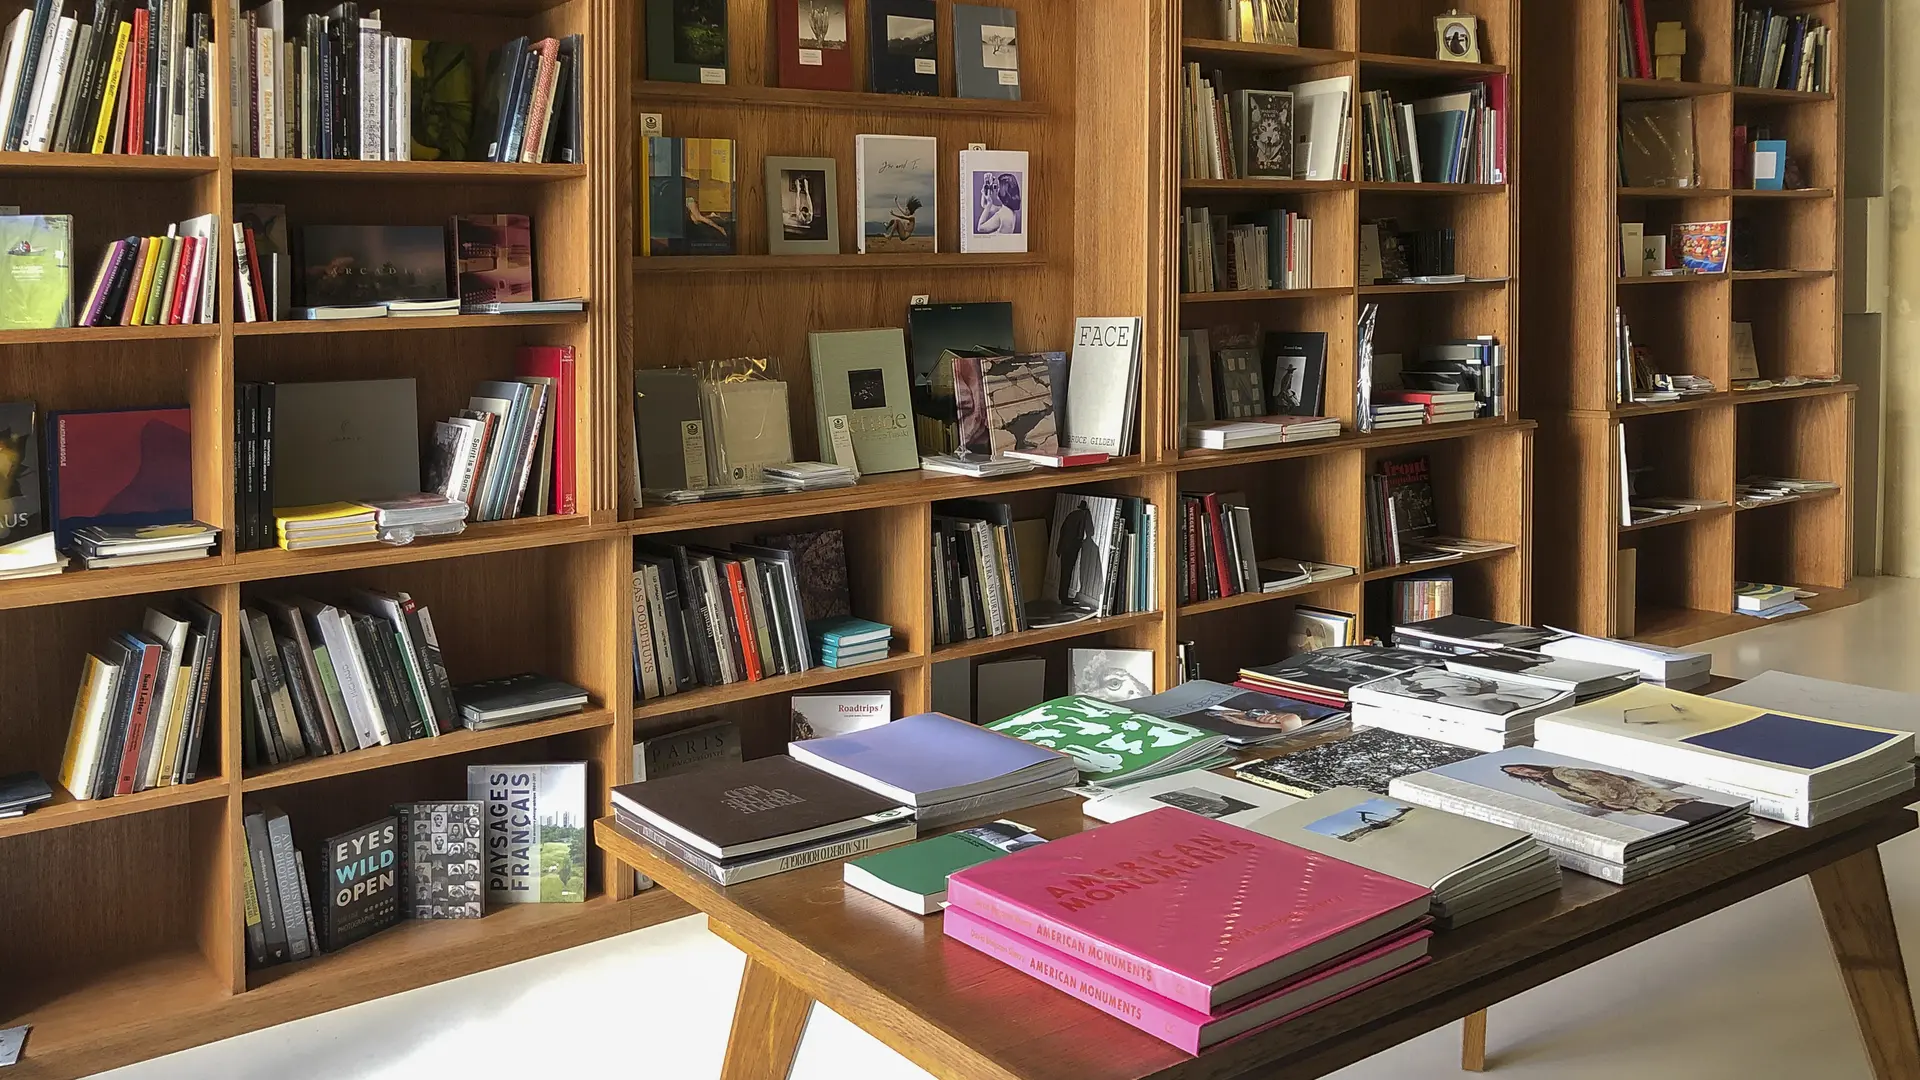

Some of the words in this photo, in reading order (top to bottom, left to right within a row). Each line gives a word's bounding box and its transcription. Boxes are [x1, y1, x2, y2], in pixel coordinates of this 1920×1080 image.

[329, 267, 423, 275] ARCADIA
[1079, 325, 1129, 347] FACE
[468, 437, 480, 458] Spirit
[1090, 436, 1115, 447] GILDEN
[460, 473, 471, 493] Bone
[979, 524, 989, 550] SUPER
[984, 554, 993, 580] EXTRA
[988, 583, 1000, 622] NATURAL!
[632, 577, 640, 602] CAS
[637, 605, 654, 674] OORTHUYS
[699, 605, 713, 638] totenstill
[203, 655, 212, 681] TALKING
[262, 639, 273, 662] SALLY
[269, 663, 280, 686] MANN
[419, 645, 431, 670] Nicholas
[426, 669, 436, 687] Nixon
[140, 672, 151, 693] Saul
[199, 681, 208, 703] STONES
[136, 692, 148, 715] Leiter
[652, 733, 725, 762] PARIS
[273, 835, 282, 849] OF
[282, 833, 290, 841] A
[337, 825, 394, 862] EYES
[490, 773, 508, 891] PAYSAGES
[511, 773, 531, 890] FRANÇAIS
[854, 839, 869, 852] LUIS
[283, 841, 297, 879] WORLD
[779, 847, 822, 871] RODRIGUEZ
[823, 842, 853, 859] ALBERTO
[1045, 831, 1222, 899] AMERICAN
[336, 849, 394, 884] WILD
[1058, 838, 1259, 913] MONUMENTS
[276, 852, 296, 929] PHOTOGRAPHY
[289, 880, 305, 926] HISTORY
[336, 870, 394, 907] OPEN
[970, 927, 985, 941] David
[1036, 923, 1086, 952] AMERICAN
[1087, 945, 1153, 982] MONUMENTS
[1029, 957, 1078, 990] AMERICAN
[1079, 980, 1143, 1020] MONUMENTS
